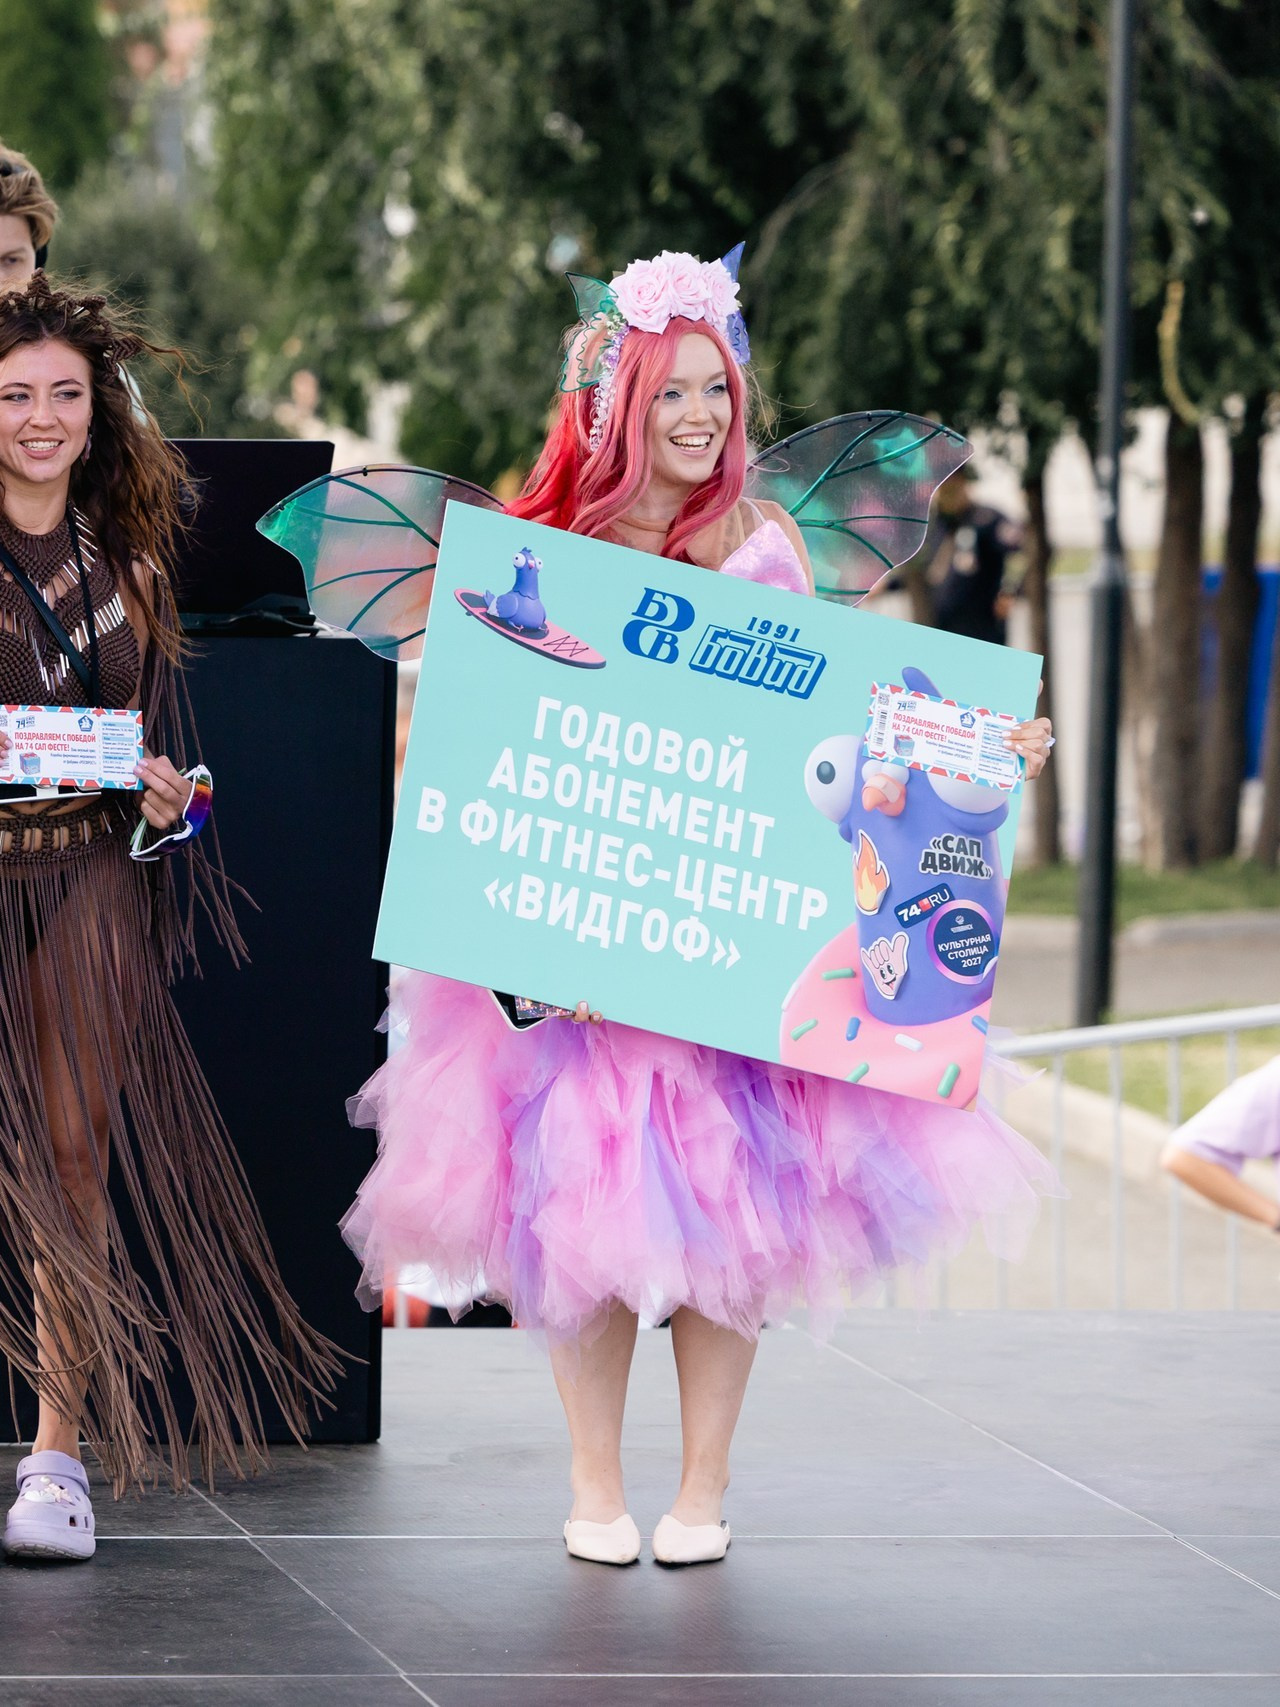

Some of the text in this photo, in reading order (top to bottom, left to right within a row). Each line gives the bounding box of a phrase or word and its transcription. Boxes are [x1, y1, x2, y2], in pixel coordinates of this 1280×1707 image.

[747, 617, 801, 643] 1991
[14, 731, 96, 743] ПОЗДРАВЛЯЕМ С ПОБЕДОЙ
[892, 722, 947, 743] НА 74 САП ФЕСТЕ!
[893, 712, 976, 740] ПОЗДРАВЛЯЕМ С ПОБЕДОЙ
[15, 742, 24, 750] НА
[25, 742, 34, 750] 74
[34, 743, 47, 751] САП
[47, 743, 70, 752] ФЕСТЕ!
[534, 696, 748, 793] ГОДОВОЙ
[487, 747, 775, 858] АБОНЕМЕНТ
[416, 786, 829, 930] В ФИТНЕС-ЦЕНТР
[483, 874, 741, 969] «ВИДГОФ»
[937, 933, 992, 953] КУЛЬТУРНАЯ
[947, 944, 989, 961] СТОЛИЦА
[960, 956, 982, 968] 2027
